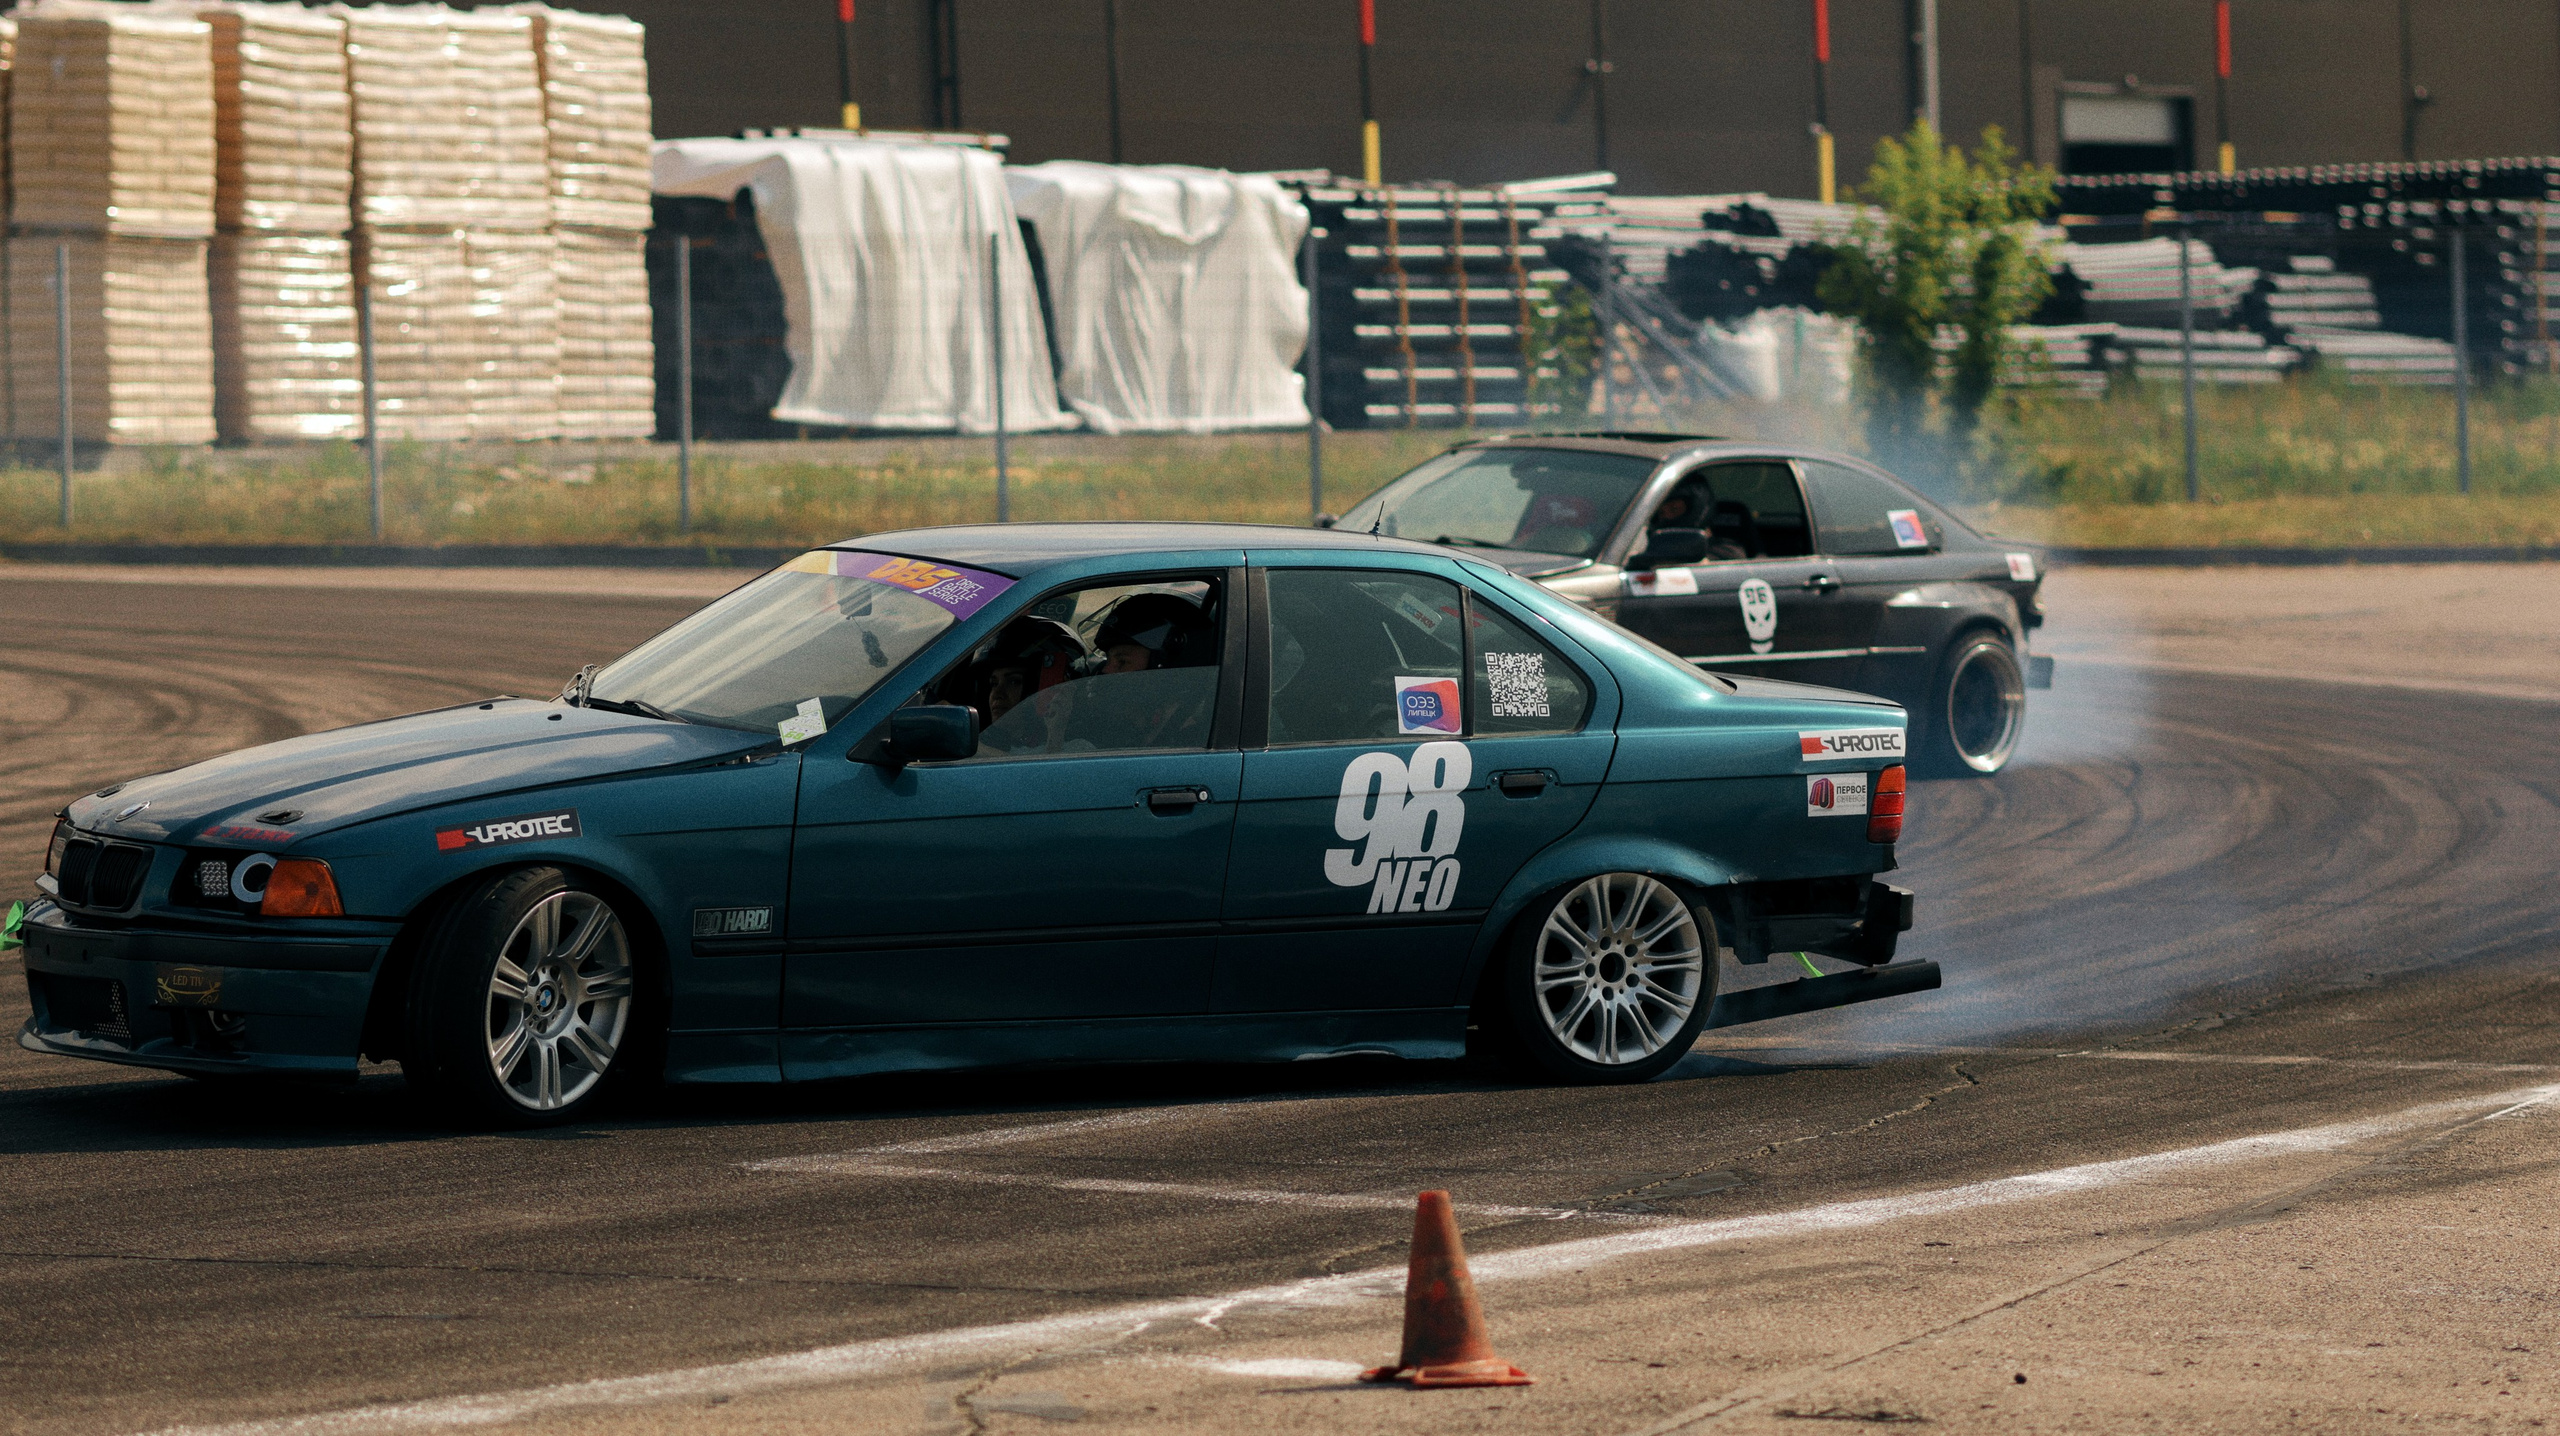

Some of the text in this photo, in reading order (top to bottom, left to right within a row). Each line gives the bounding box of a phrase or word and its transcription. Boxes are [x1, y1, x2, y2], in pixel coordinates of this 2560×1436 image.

[867, 557, 962, 589] DBS
[946, 582, 978, 601] BATTLE
[955, 577, 985, 593] DRIFT
[928, 587, 963, 605] SERIES
[1745, 587, 1767, 604] 96
[1406, 695, 1436, 709] ОЭЗ
[1407, 709, 1437, 718] ЛИПЕЦК
[1836, 785, 1866, 795] ПЕРВОЕ
[1324, 741, 1472, 887] 98
[1366, 857, 1461, 915] NEO
[724, 908, 770, 932] HARD!
[173, 975, 188, 986] LED
